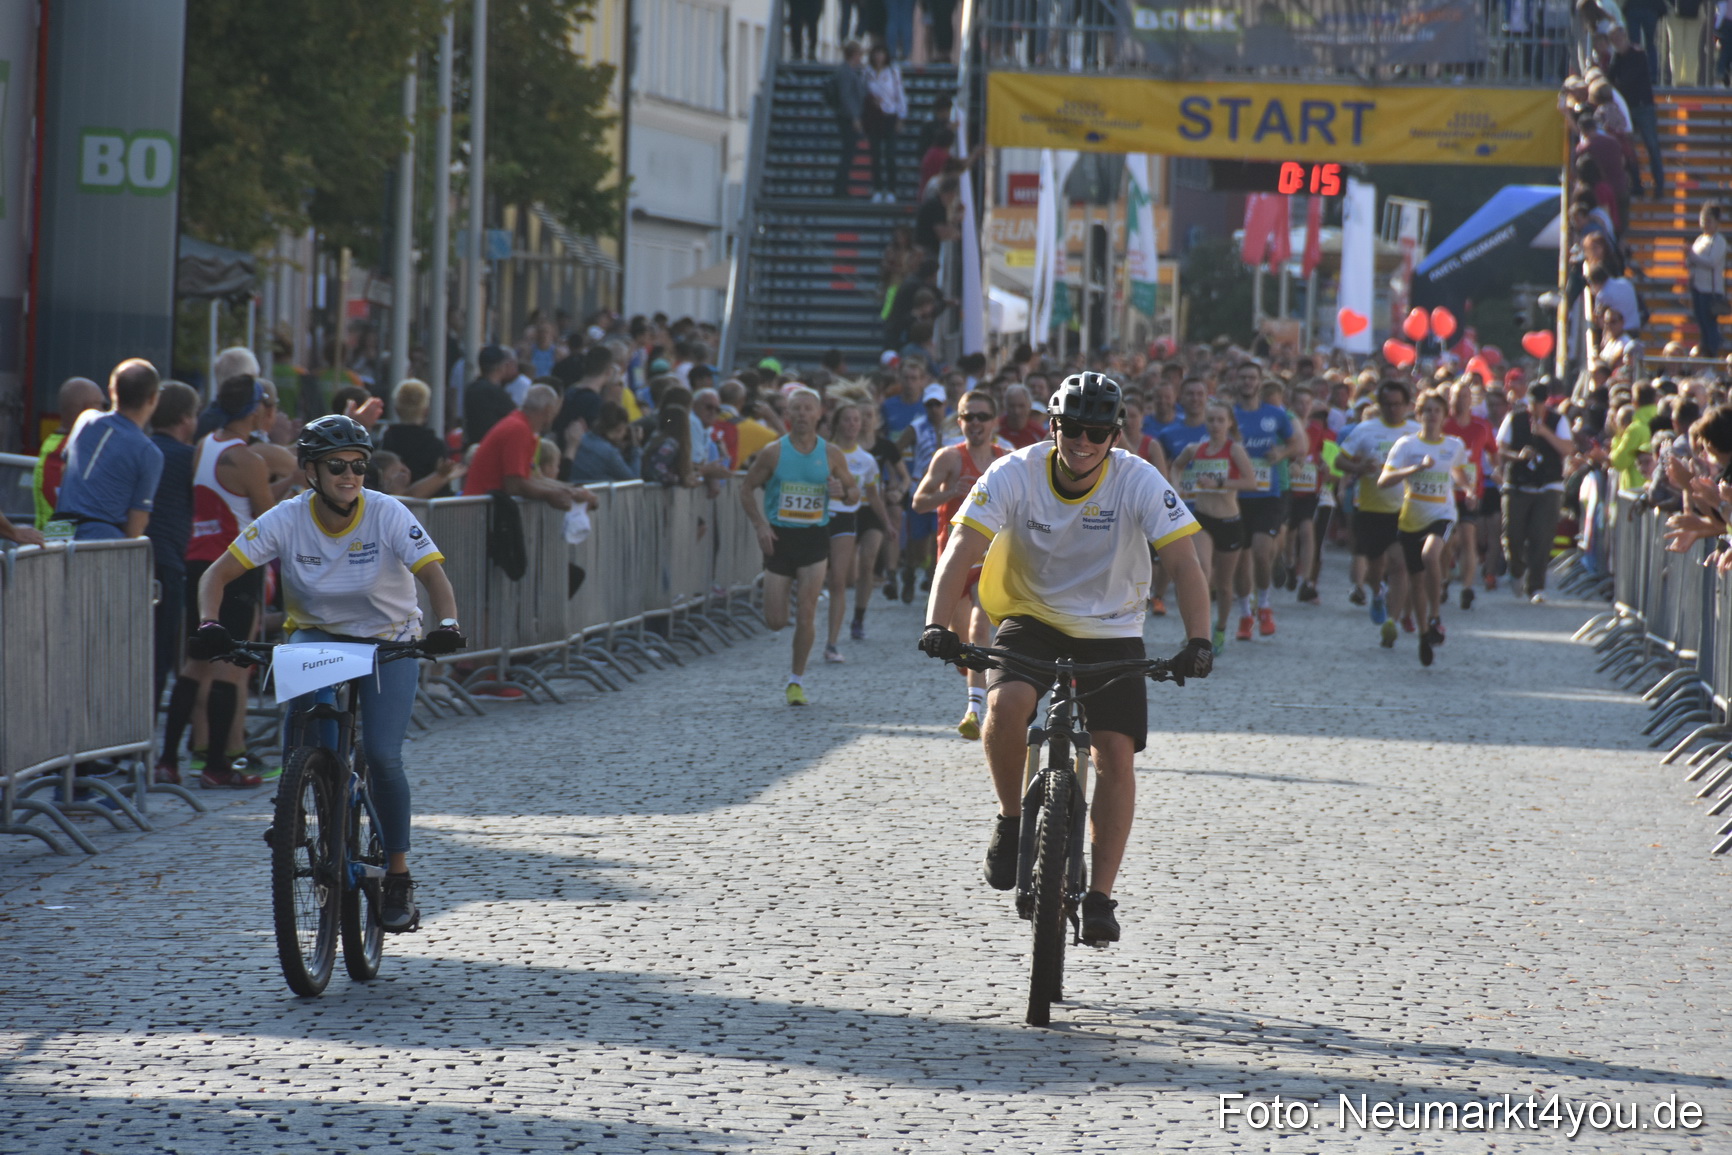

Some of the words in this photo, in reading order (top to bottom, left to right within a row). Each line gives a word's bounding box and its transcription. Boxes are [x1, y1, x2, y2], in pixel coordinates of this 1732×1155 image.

[1177, 95, 1376, 146] START
[83, 135, 173, 188] BO
[1278, 162, 1341, 196] 0:15
[1460, 224, 1517, 265] NEUMARKT
[784, 496, 822, 509] 5126
[1082, 505, 1099, 516] 20
[349, 541, 362, 551] 20
[302, 656, 344, 671] Funrun
